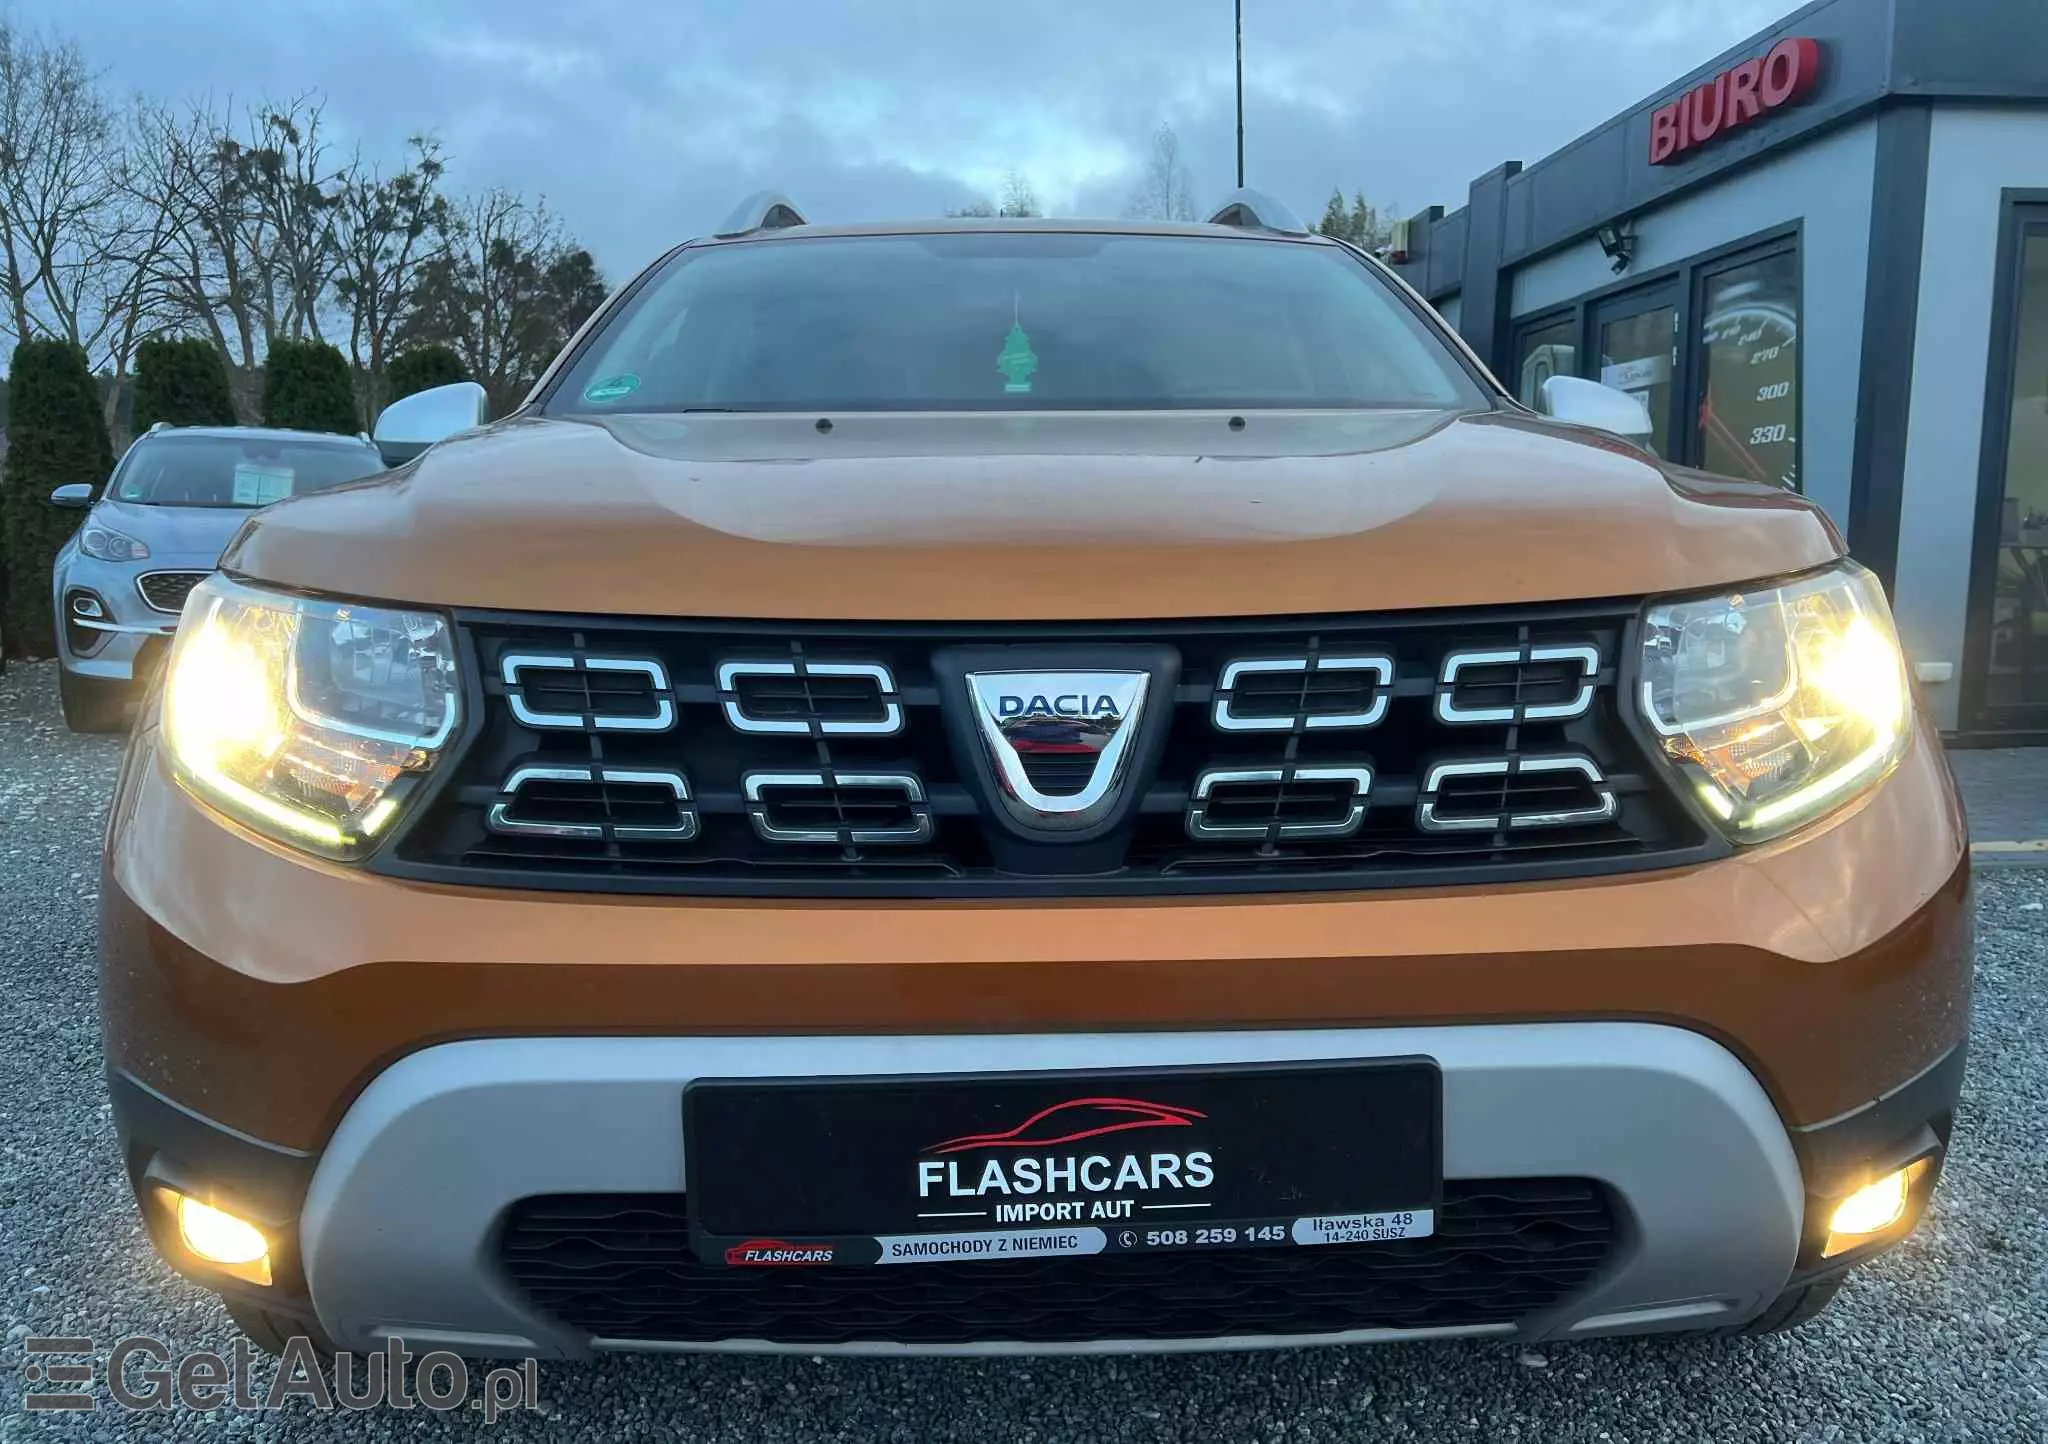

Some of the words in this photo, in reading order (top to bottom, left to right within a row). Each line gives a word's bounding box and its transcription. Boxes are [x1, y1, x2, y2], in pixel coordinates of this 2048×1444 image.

[1649, 38, 1819, 165] BIURO
[1750, 346, 1780, 364] 270
[1757, 382, 1789, 401] 300
[1750, 424, 1786, 444] 330
[1000, 695, 1120, 717] DACIA
[919, 1152, 1214, 1197] FLASHCARS
[996, 1202, 1084, 1222] IMPORT
[1091, 1200, 1135, 1219] AUT
[1391, 1212, 1413, 1226] 48
[1146, 1230, 1188, 1246] 508
[1195, 1228, 1237, 1244] 259
[1244, 1225, 1285, 1242] 145
[1325, 1229, 1369, 1242] 14-240
[1373, 1227, 1406, 1240] SUSZ
[745, 1250, 833, 1262] FLASHCARS
[892, 1239, 993, 1257] SAMOCHODY
[998, 1238, 1007, 1252] Z
[1012, 1235, 1078, 1250] NIEMIEC
